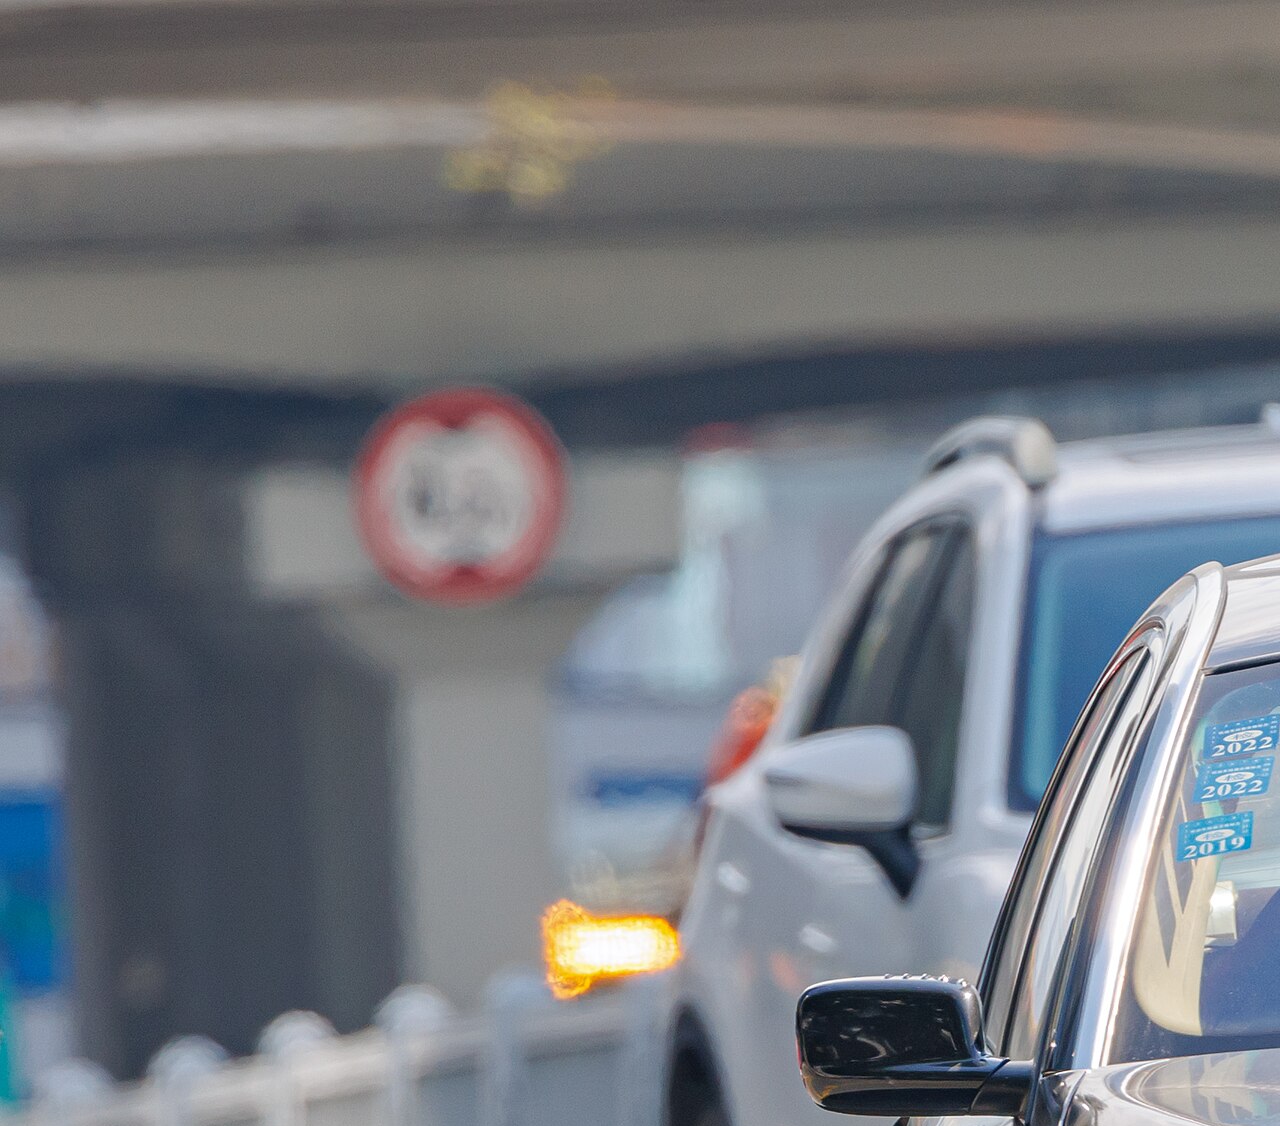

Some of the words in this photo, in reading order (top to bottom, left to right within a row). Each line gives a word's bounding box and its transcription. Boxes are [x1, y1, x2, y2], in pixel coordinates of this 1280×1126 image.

[1211, 736, 1273, 757] 2022
[1200, 779, 1263, 799] 2022
[1184, 836, 1246, 859] 2019
